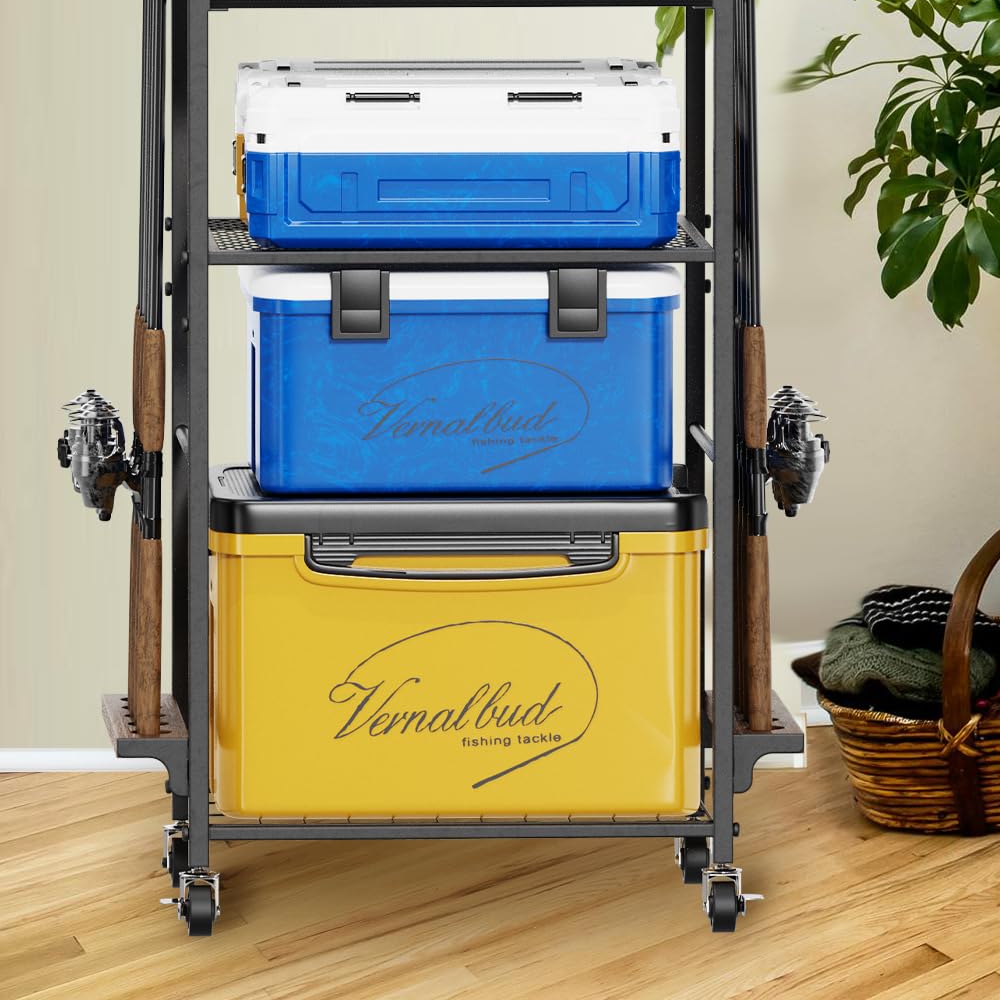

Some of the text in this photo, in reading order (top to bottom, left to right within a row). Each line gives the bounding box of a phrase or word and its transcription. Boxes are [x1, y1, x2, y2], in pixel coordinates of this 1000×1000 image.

[328, 677, 563, 740] Vernalbud
[461, 732, 562, 747] fishing tackle
